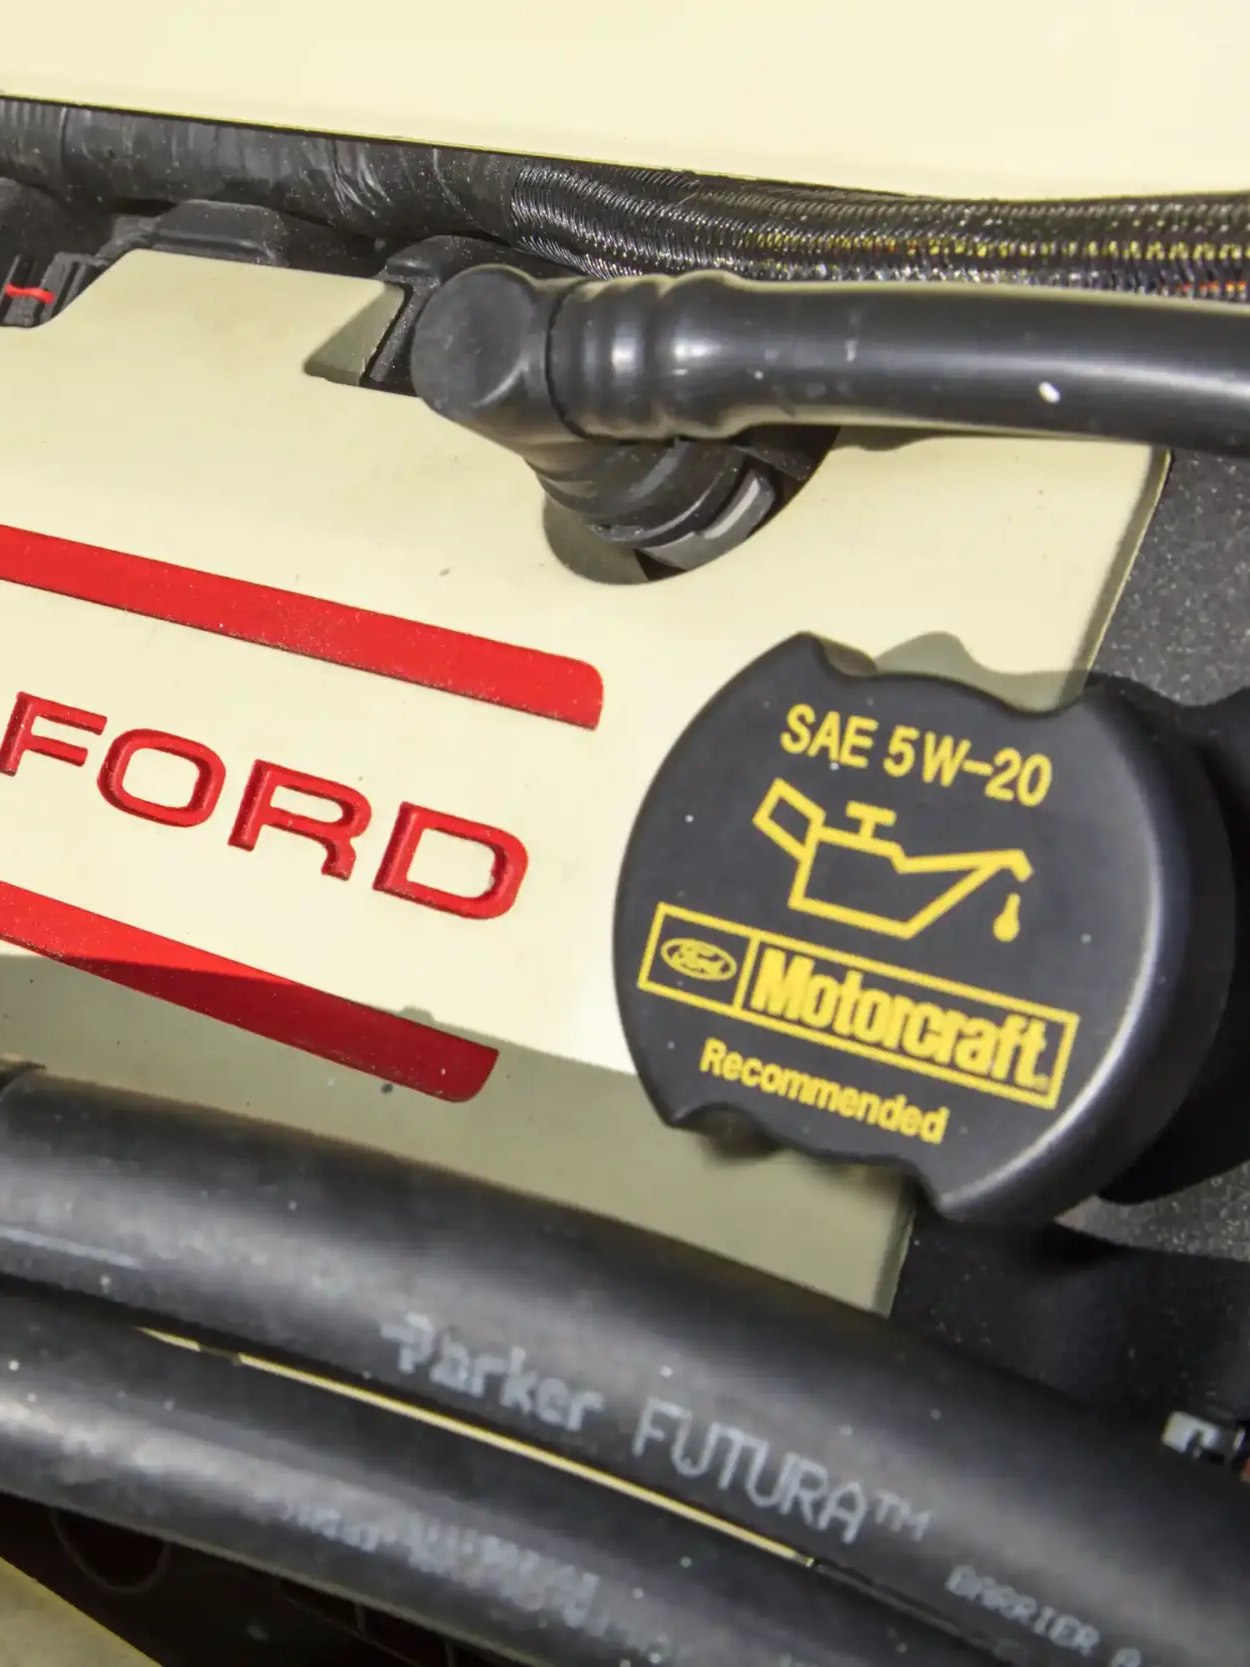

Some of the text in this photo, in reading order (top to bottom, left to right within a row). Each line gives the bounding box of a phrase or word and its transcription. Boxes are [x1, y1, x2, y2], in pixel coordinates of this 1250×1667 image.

[780, 703, 877, 768] SAE
[700, 1037, 949, 1144] Recommended
[380, 1311, 606, 1433] Parker
